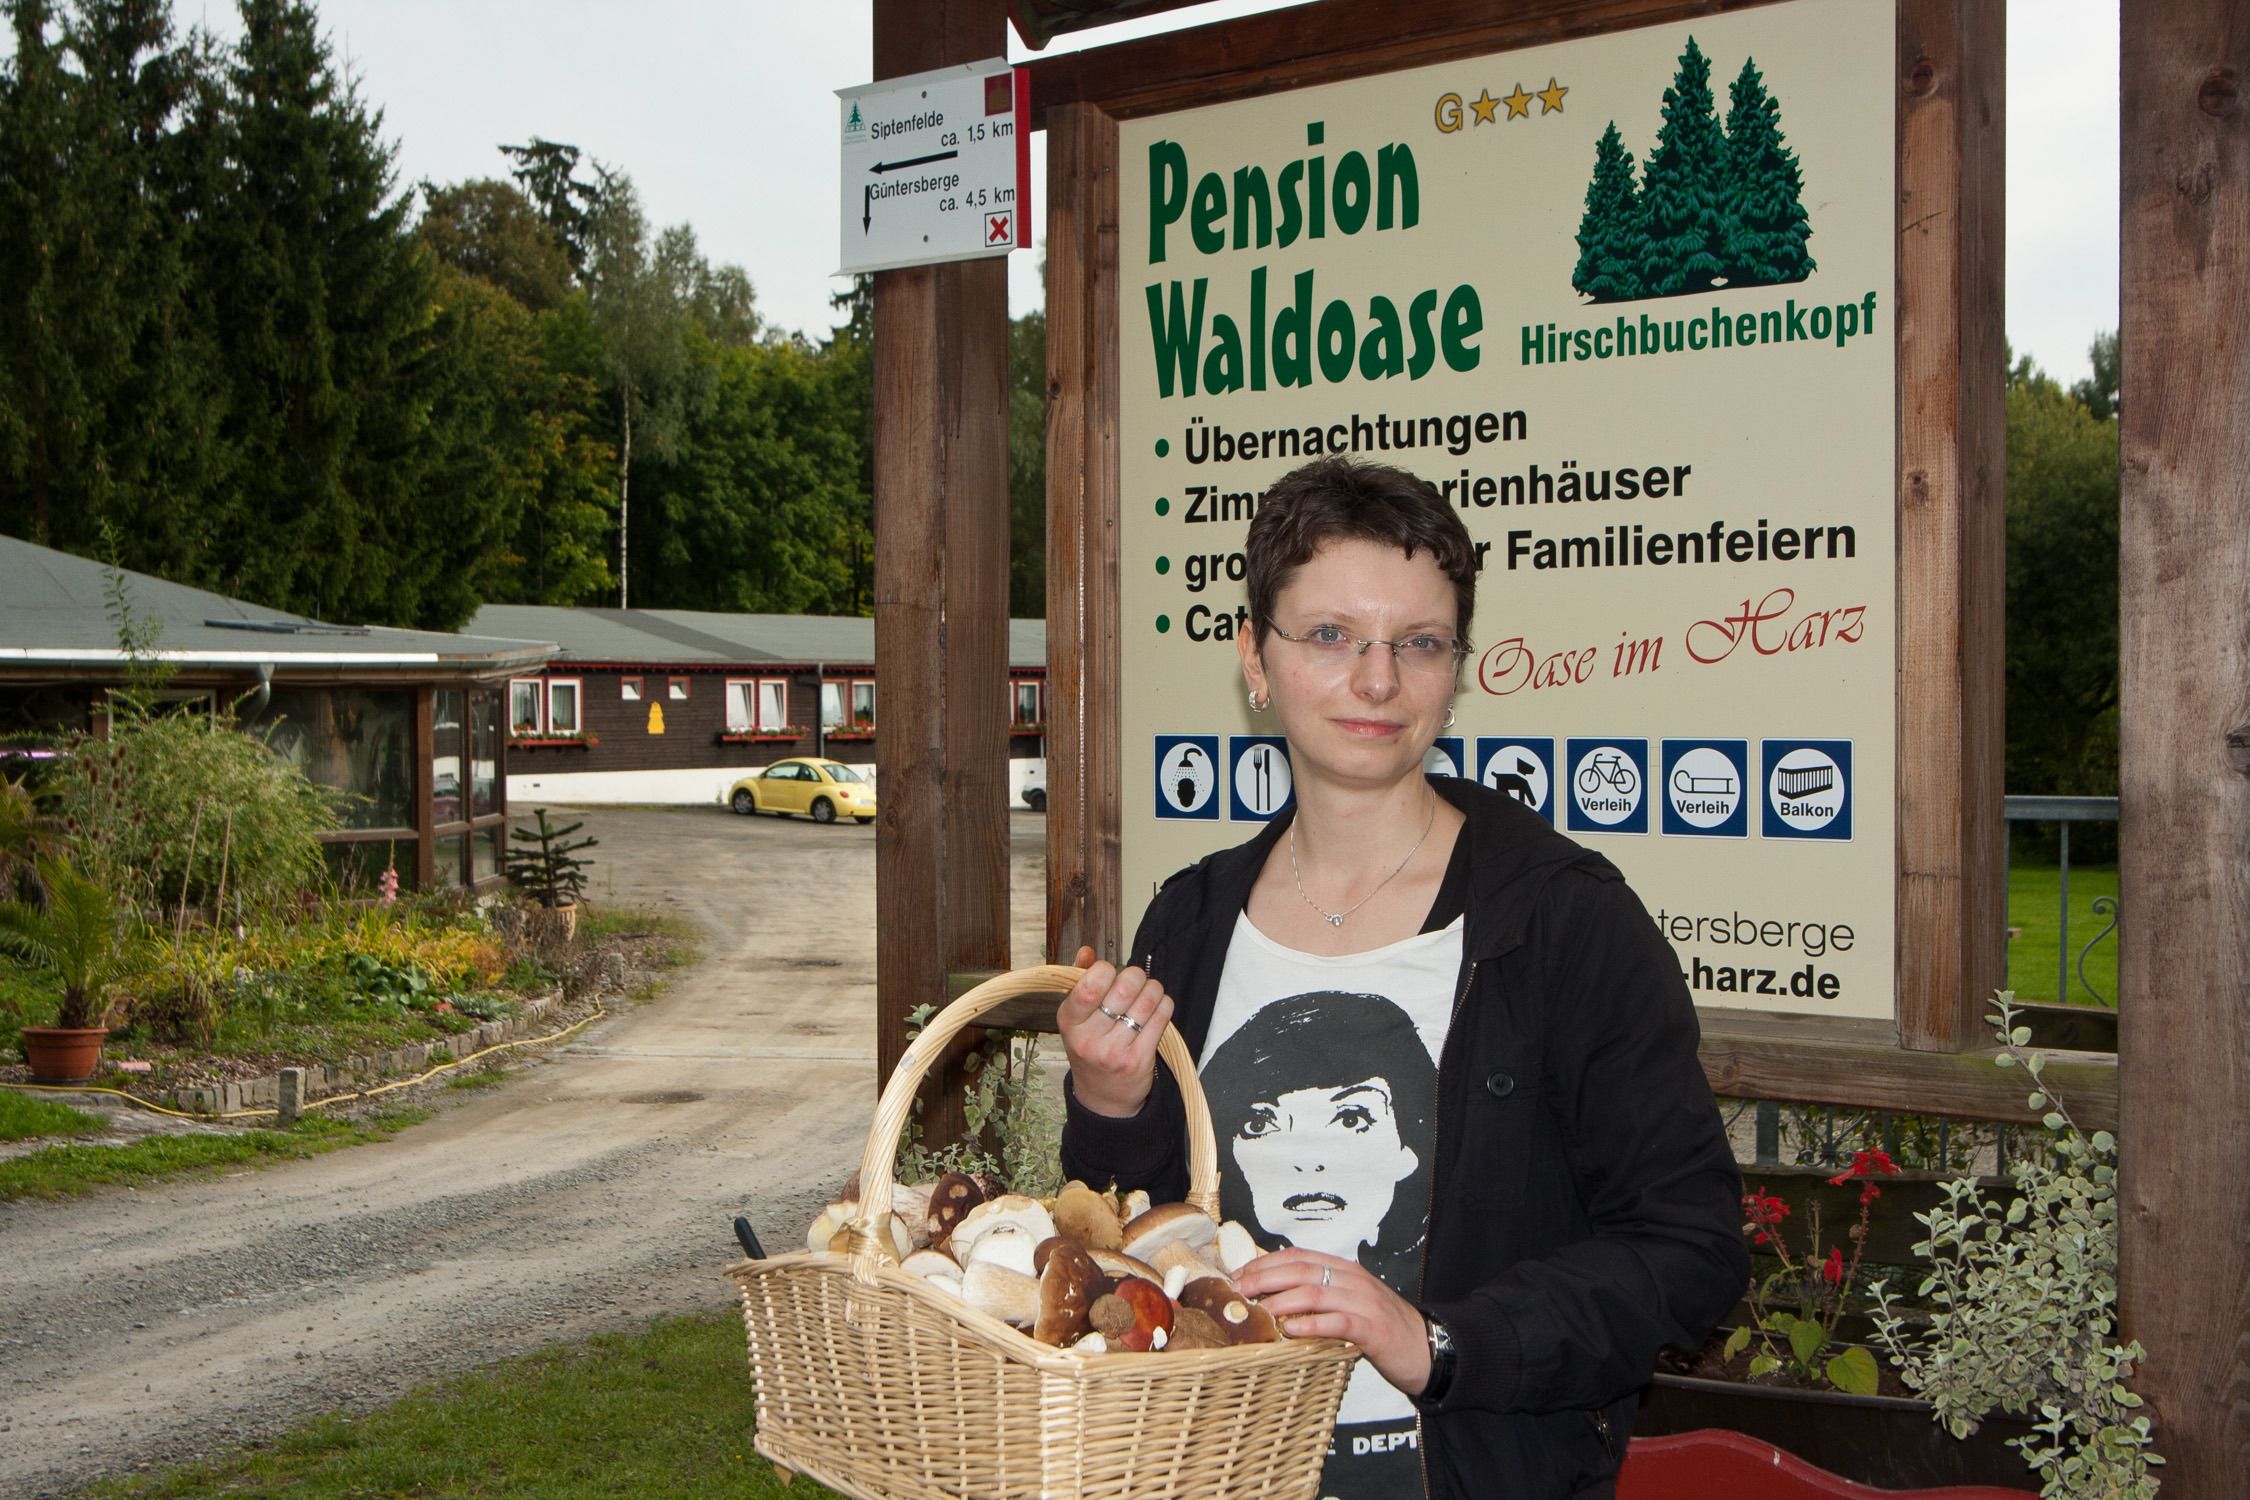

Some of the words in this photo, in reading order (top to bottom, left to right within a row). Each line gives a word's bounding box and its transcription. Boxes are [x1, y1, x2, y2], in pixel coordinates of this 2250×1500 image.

[871, 111, 944, 141] Siptenfelde
[941, 132, 960, 147] ca.
[967, 124, 985, 144] 1,5
[992, 121, 1013, 138] km
[870, 173, 960, 201] Güntersberge
[939, 197, 959, 212] ca.
[966, 188, 987, 209] 4,5
[994, 186, 1015, 204] km
[1149, 121, 1419, 265] Pension
[1145, 265, 1483, 399] Waldoase
[1521, 291, 1877, 366] Hirschbuchenkopf
[1185, 411, 1528, 466] Übernachtungen
[1185, 485, 1265, 523] Zim
[1507, 519, 1856, 571] Familienfeiern
[1478, 637, 1597, 696] Oase
[1613, 631, 1664, 679] im
[1685, 587, 1867, 665] Harz
[1581, 797, 1632, 812] Verleih
[1676, 800, 1730, 815] Verleih
[1780, 802, 1834, 818] Balkon
[1352, 1430, 1418, 1456] DEPT
